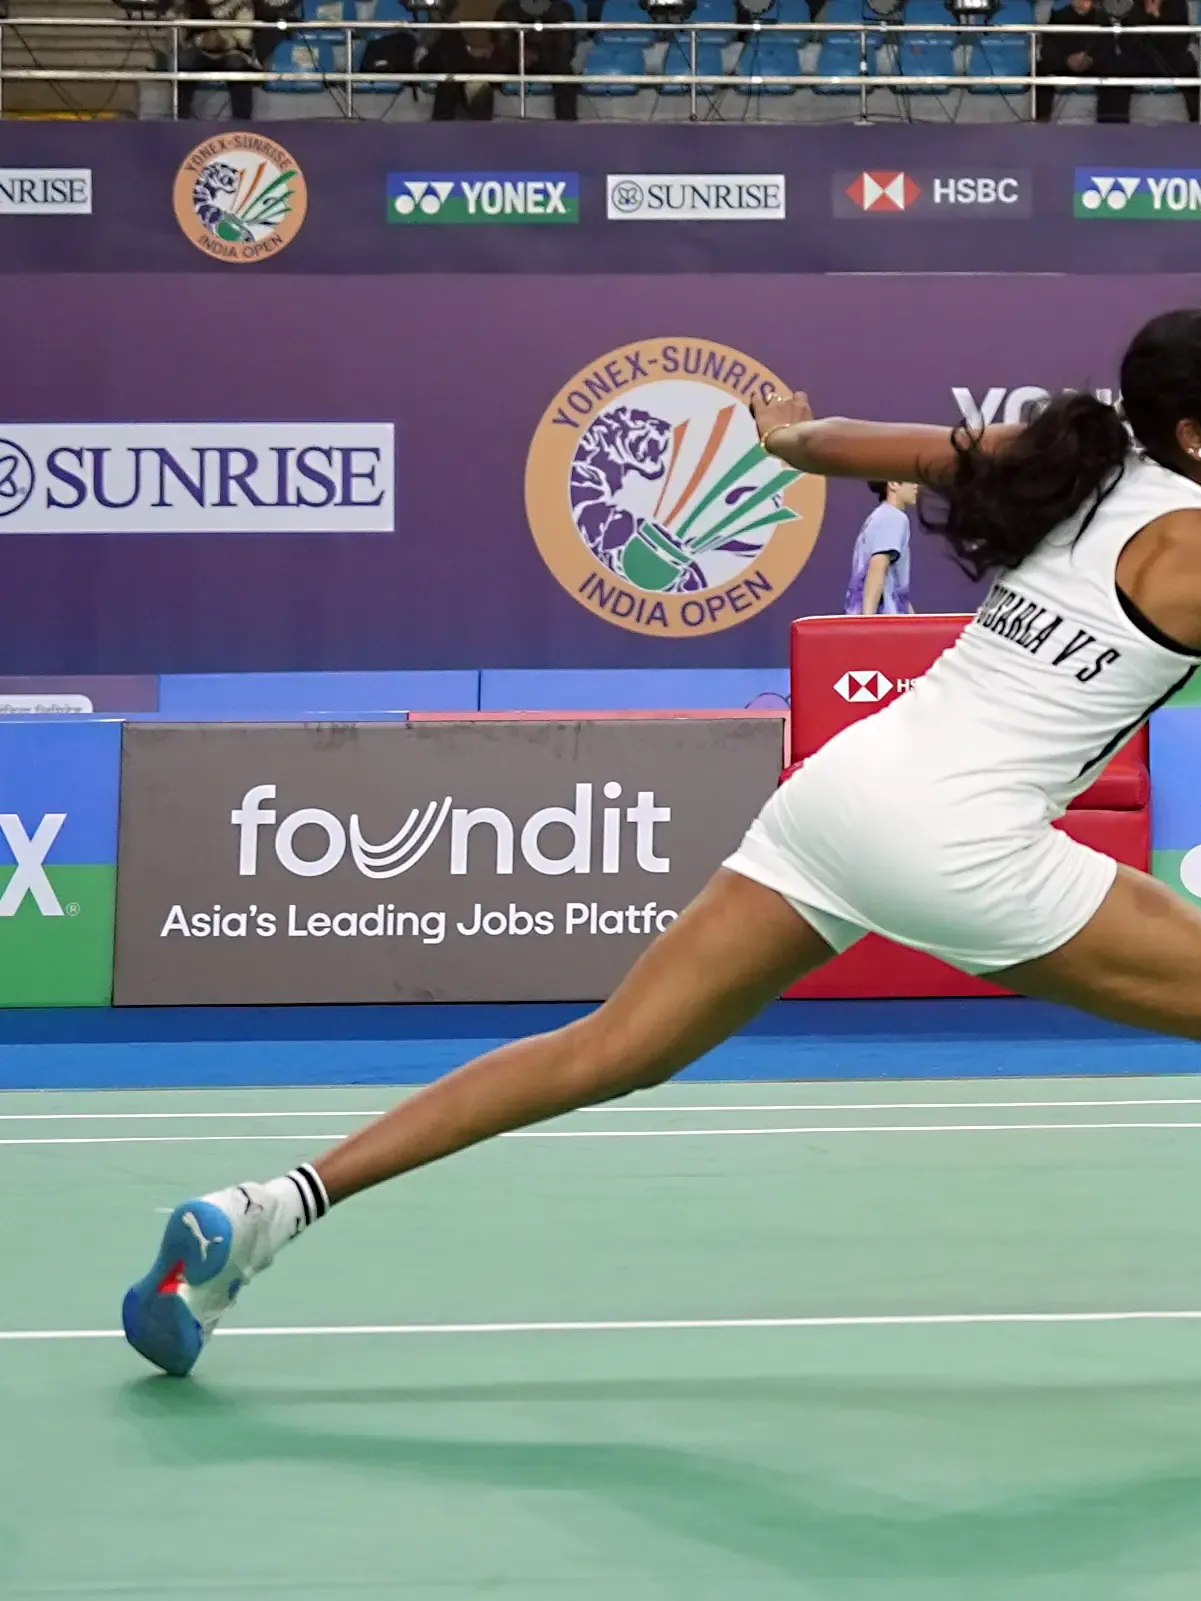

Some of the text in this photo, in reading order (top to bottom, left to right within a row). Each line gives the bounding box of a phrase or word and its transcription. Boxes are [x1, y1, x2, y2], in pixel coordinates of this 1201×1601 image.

[461, 181, 566, 214] YONEX
[647, 184, 781, 209] SUNRISE
[933, 177, 1019, 204] HSBC
[200, 232, 283, 258] INDIA OPEN
[47, 446, 385, 508] SUNRISE
[578, 571, 773, 628] INDIA OPEN
[231, 781, 671, 879] foundit
[160, 904, 276, 937] Asia's
[288, 903, 446, 944] Leading
[456, 903, 554, 936] Jobs
